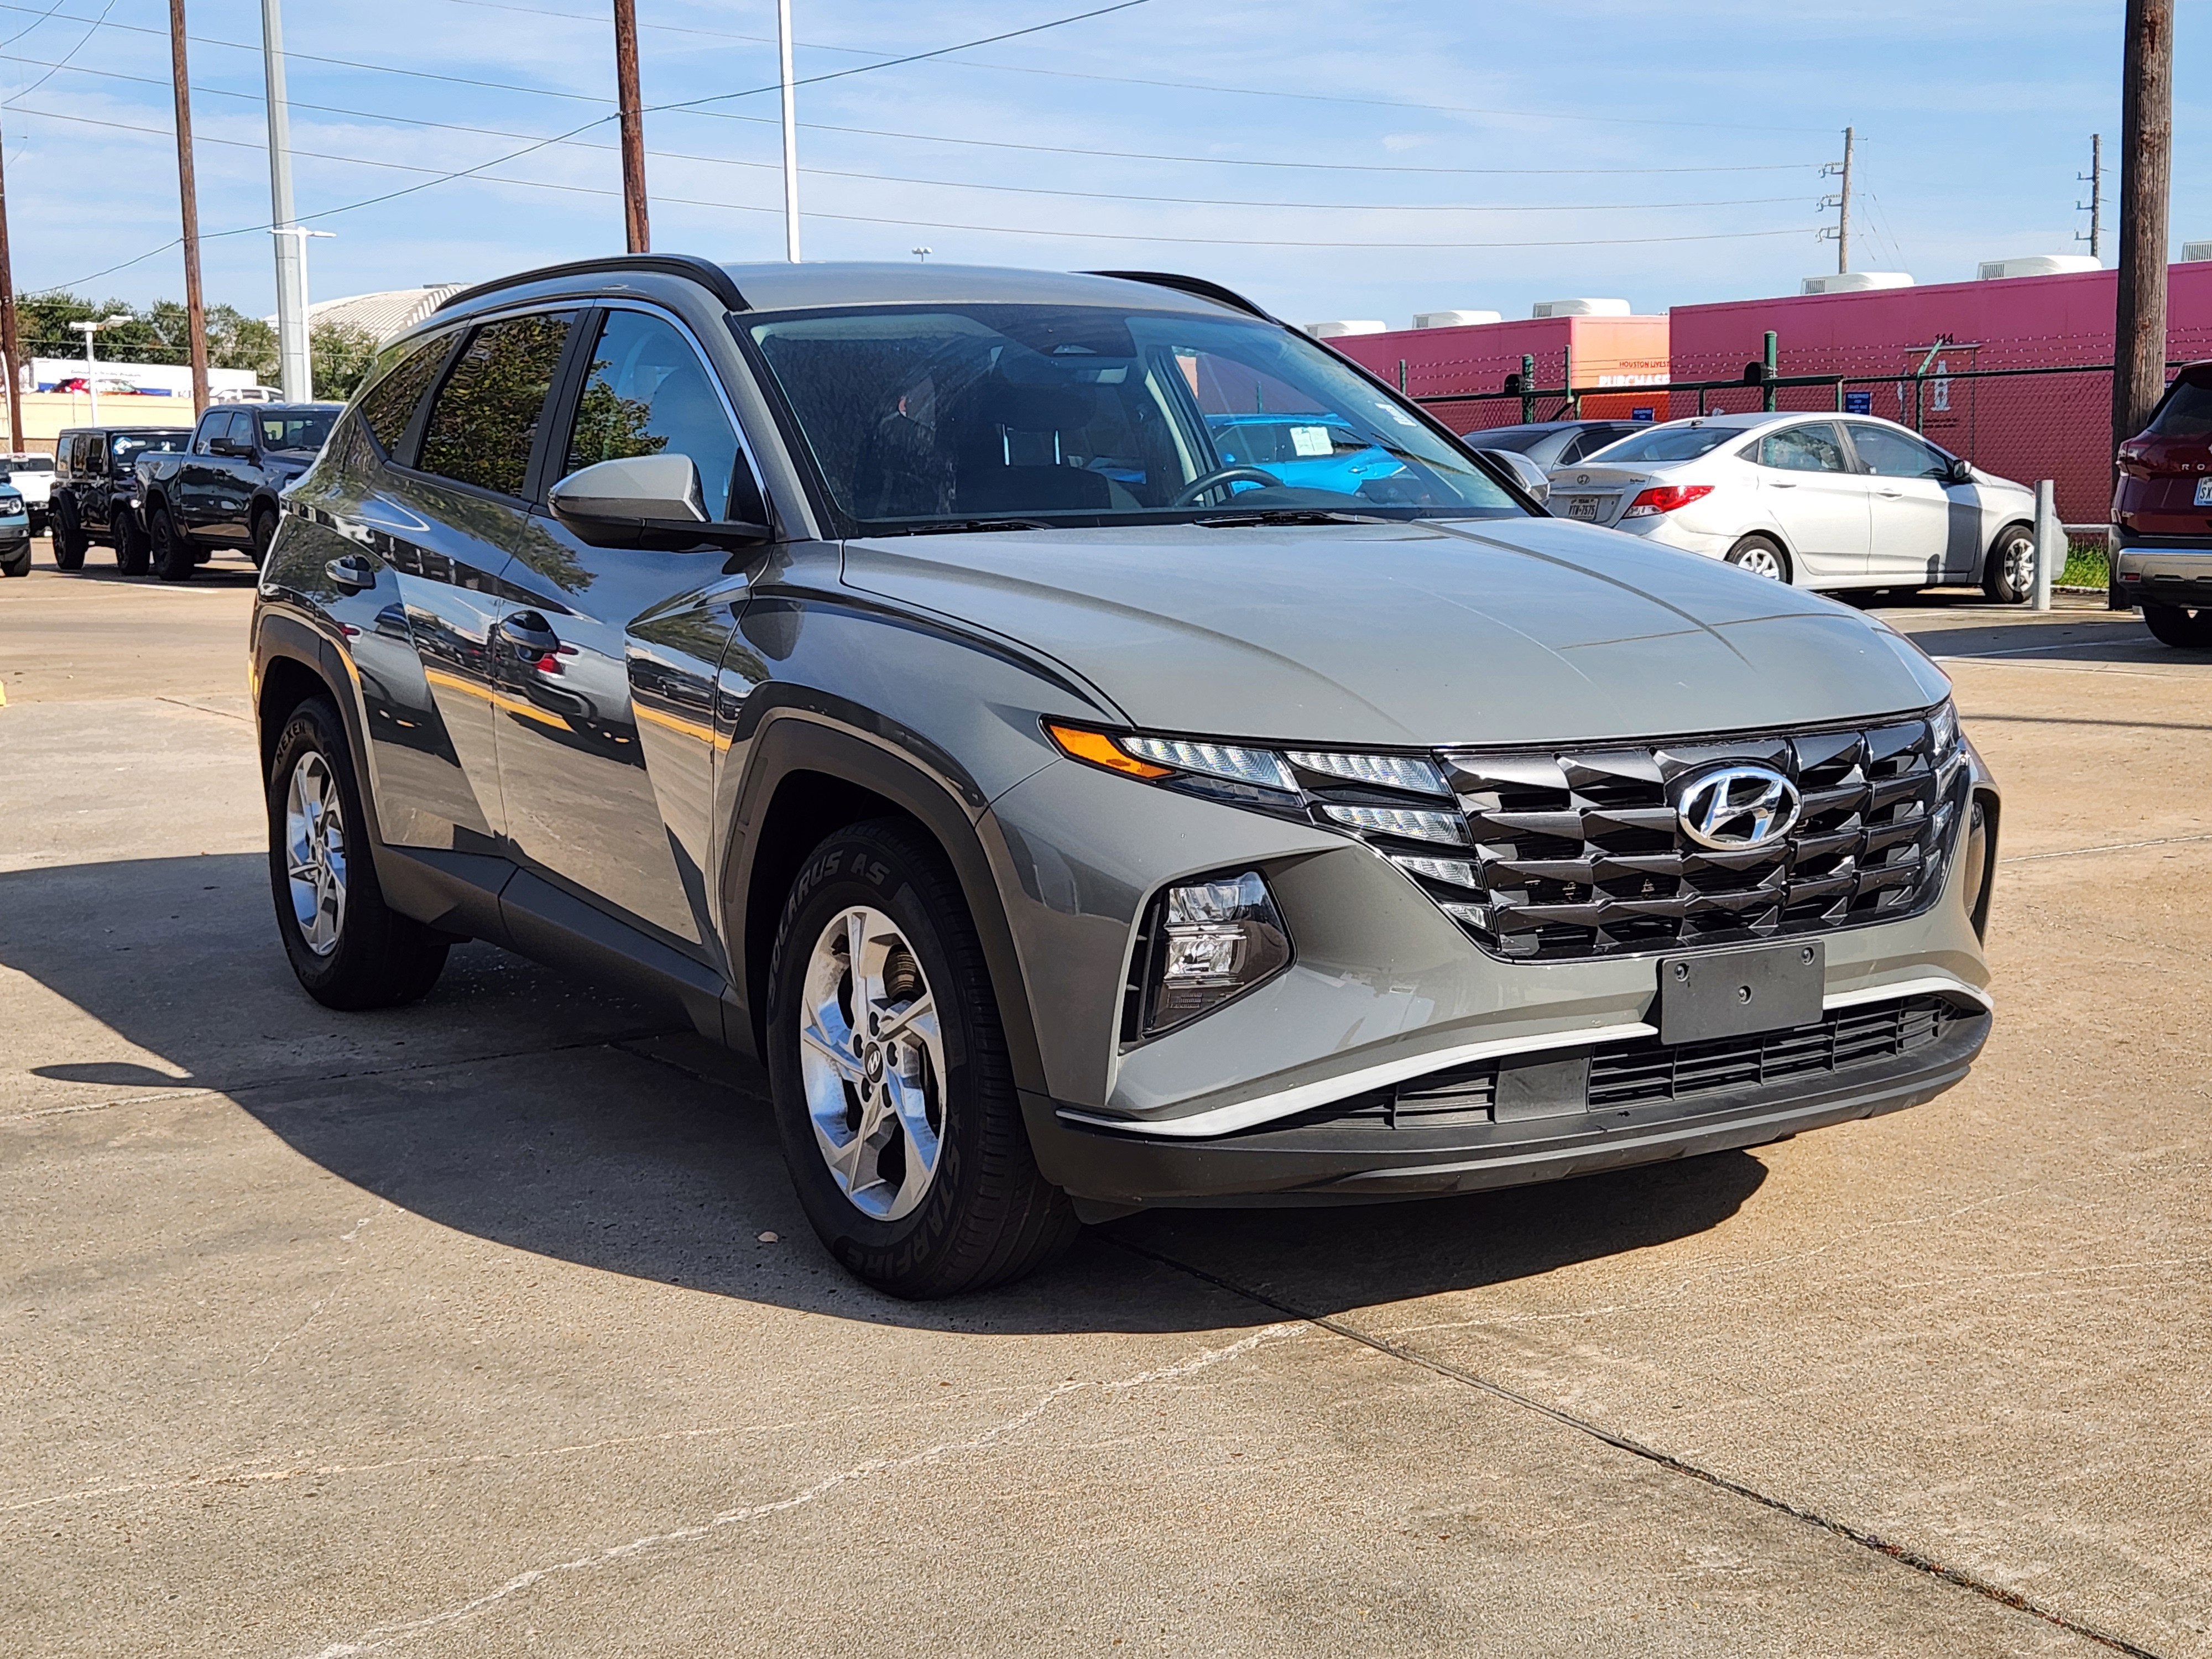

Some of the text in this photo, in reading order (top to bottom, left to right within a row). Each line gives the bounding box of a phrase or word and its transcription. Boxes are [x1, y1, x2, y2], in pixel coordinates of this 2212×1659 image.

[276, 721, 306, 764] NEXEN
[851, 853, 891, 886] AS
[847, 1135, 961, 1279] STARFIRE
